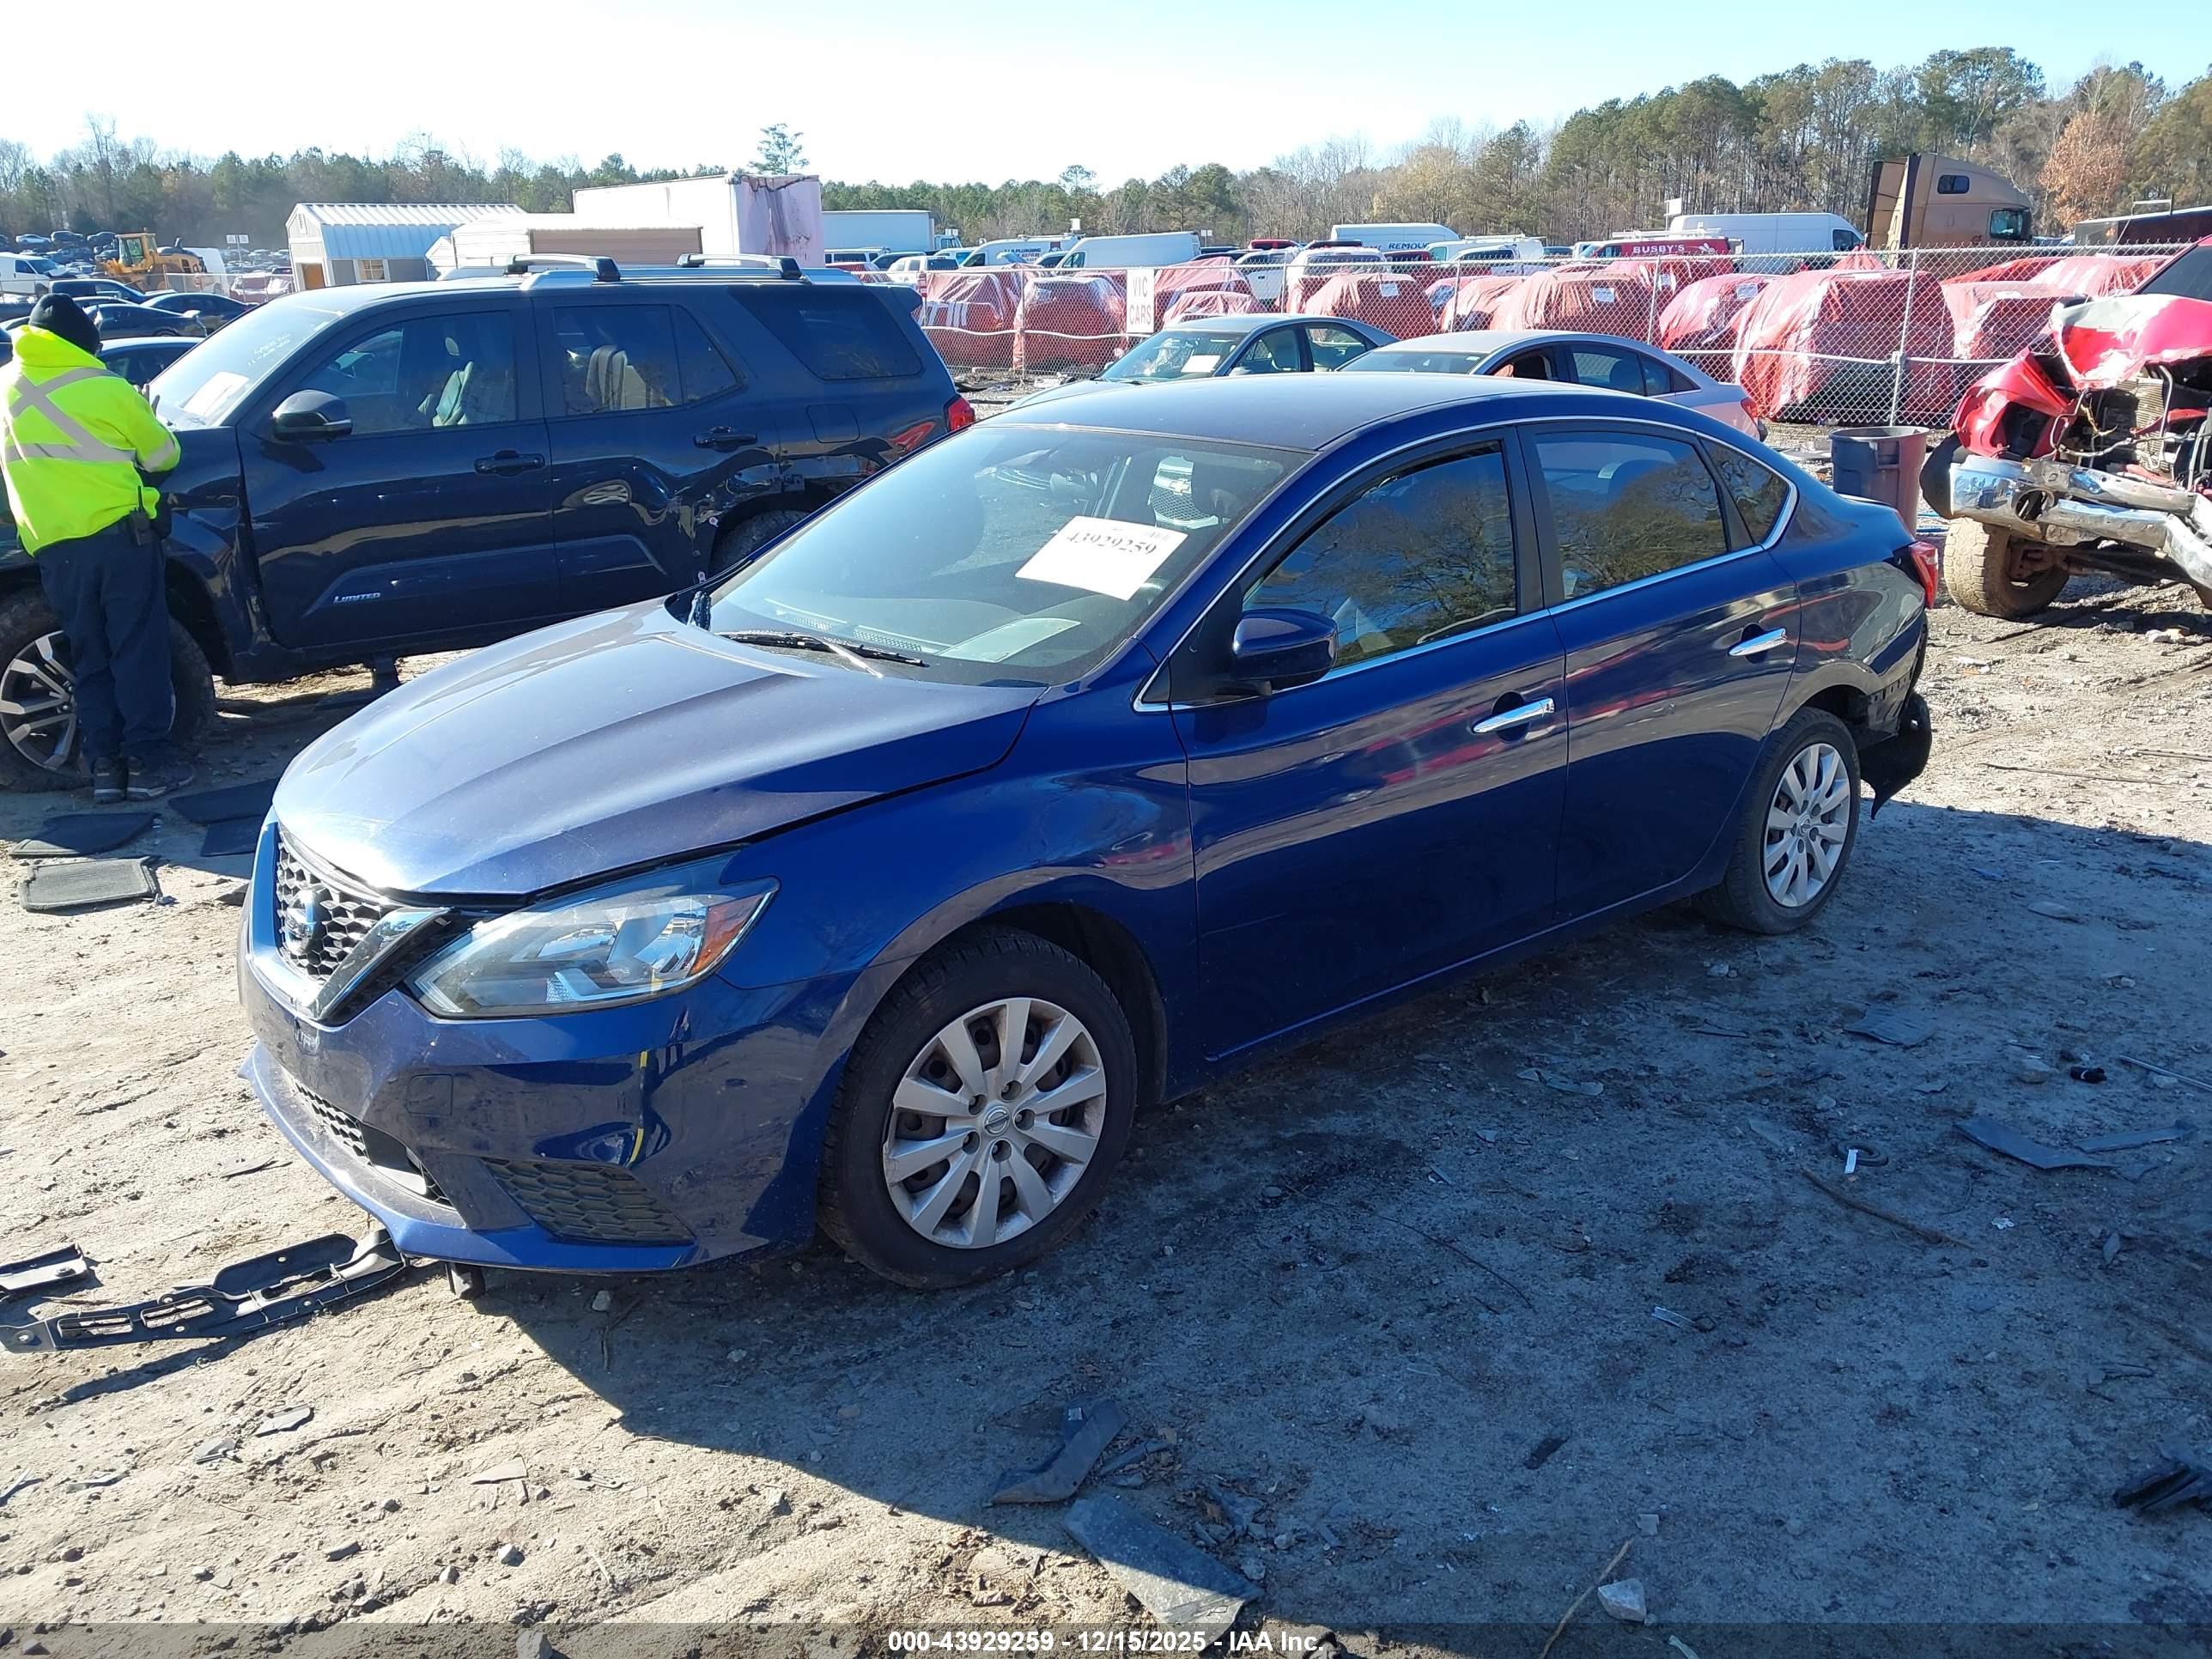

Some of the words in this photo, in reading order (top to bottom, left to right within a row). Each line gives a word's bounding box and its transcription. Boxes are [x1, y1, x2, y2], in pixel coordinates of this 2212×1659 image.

[1632, 244, 1685, 254] BUSBY'S
[1133, 276, 1148, 298] VIC
[1129, 304, 1152, 325] CARS
[1066, 532, 1157, 554] 43929259
